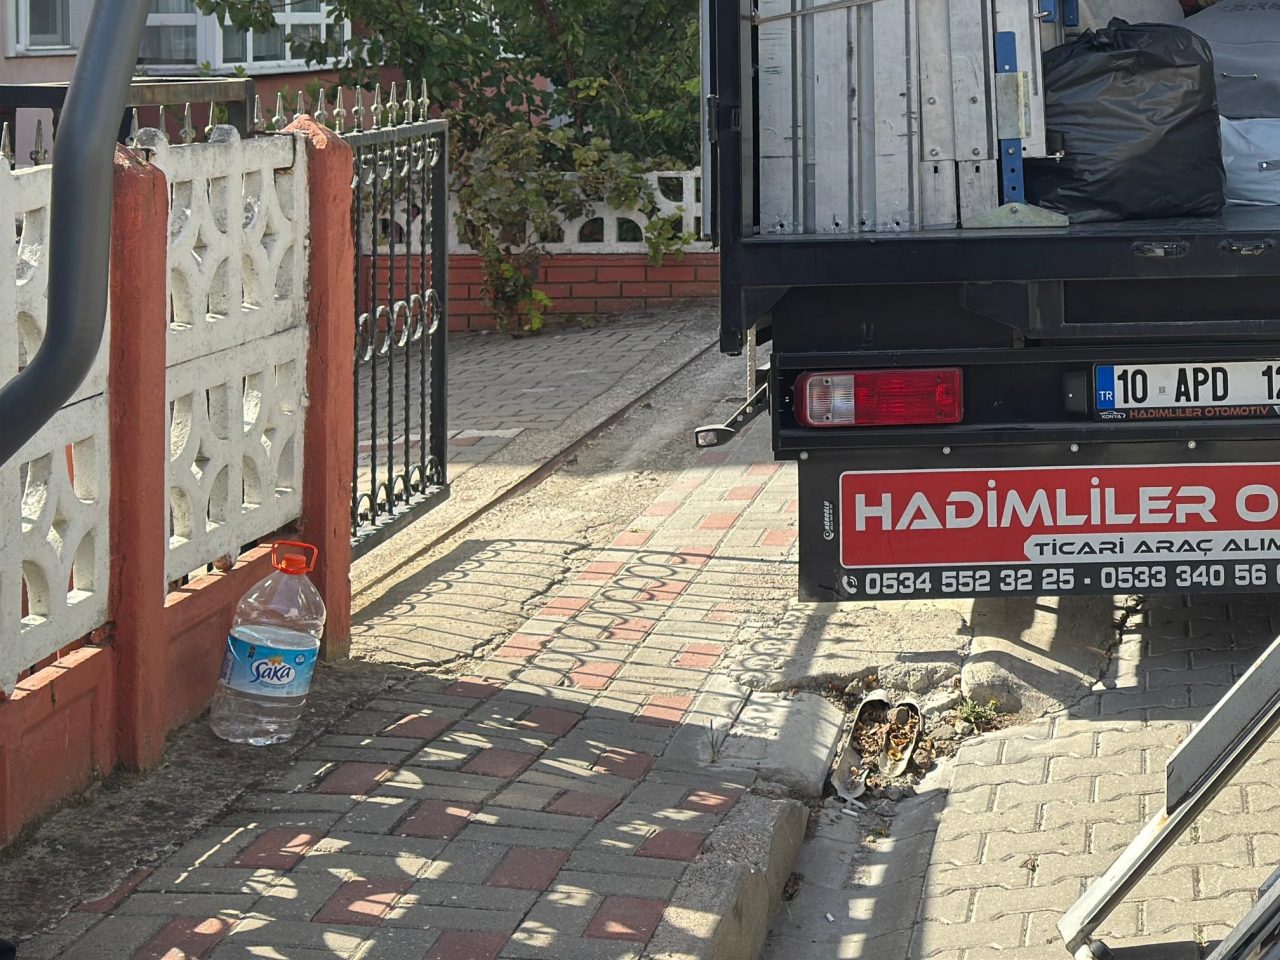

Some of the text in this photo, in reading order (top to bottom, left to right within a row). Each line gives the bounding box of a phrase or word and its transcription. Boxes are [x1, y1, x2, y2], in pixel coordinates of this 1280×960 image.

[1099, 391, 1113, 401] TR
[1117, 369, 1148, 404] 10
[1174, 367, 1229, 403] APD
[855, 476, 1218, 531] HADİMLİLER
[1033, 537, 1125, 556] TİCARİ
[1133, 539, 1213, 556] ARAÇ
[865, 572, 932, 595] 0534
[941, 570, 991, 593] 552
[1000, 569, 1033, 591] 32
[1042, 568, 1075, 590] 25
[1101, 565, 1167, 589] 0533
[1176, 564, 1225, 587] 340
[1234, 563, 1267, 586] 56
